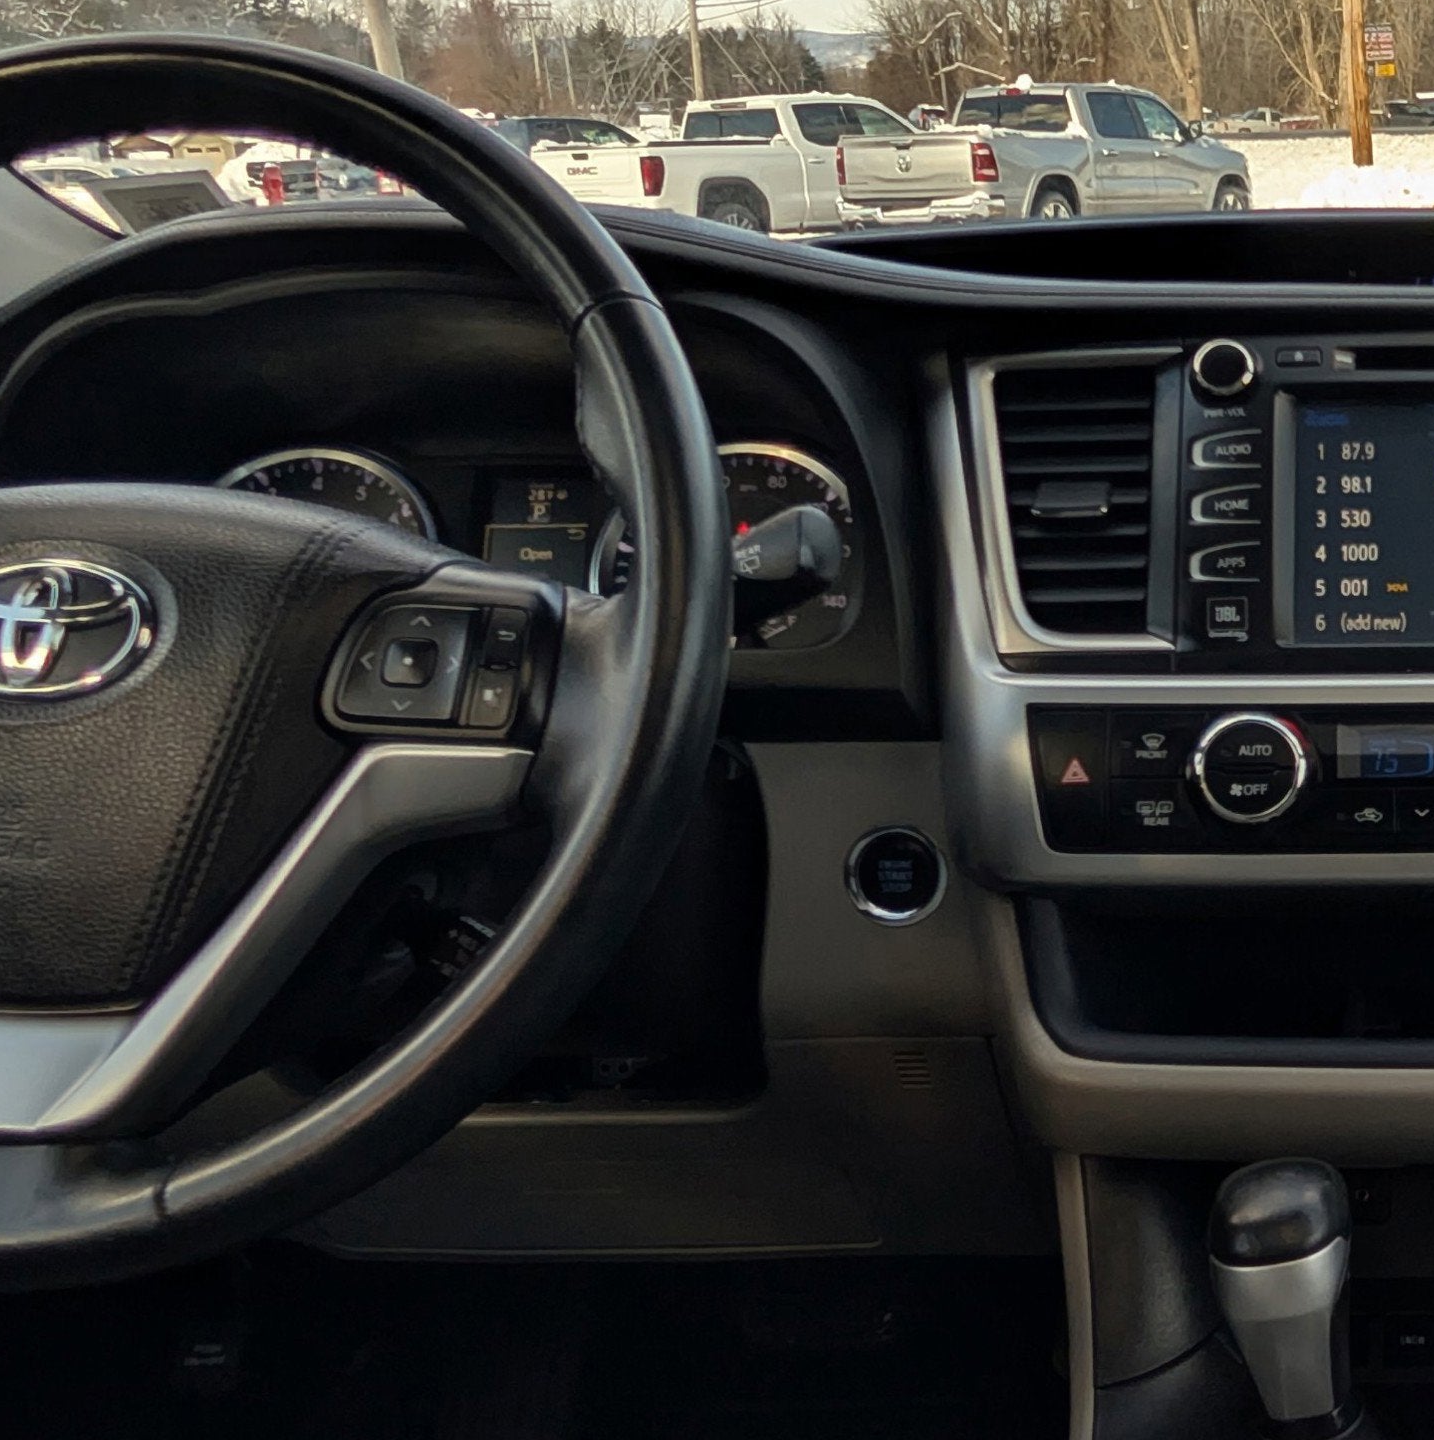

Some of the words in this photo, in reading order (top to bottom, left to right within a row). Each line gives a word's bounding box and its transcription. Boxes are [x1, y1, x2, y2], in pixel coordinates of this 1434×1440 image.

[1215, 443, 1251, 457] AUDIO
[1317, 442, 1325, 460] 1
[1341, 442, 1375, 461] 87.9
[767, 475, 787, 489] 80
[1315, 476, 1327, 495] 2
[1341, 476, 1373, 495] 98.1
[1215, 498, 1249, 511] HOME
[1315, 510, 1327, 529] 3
[1341, 510, 1372, 529] 530
[1314, 544, 1327, 563] 4
[1341, 544, 1379, 563] 1000
[1216, 556, 1246, 569] APPS
[1315, 580, 1327, 598] 5
[1341, 580, 1369, 598] 001
[1214, 606, 1241, 623] JBL
[1315, 614, 1327, 632] 6
[1340, 612, 1372, 634] (add
[1374, 612, 1407, 634] new)
[1238, 744, 1273, 757] AUTO
[1244, 782, 1268, 795] OFF
